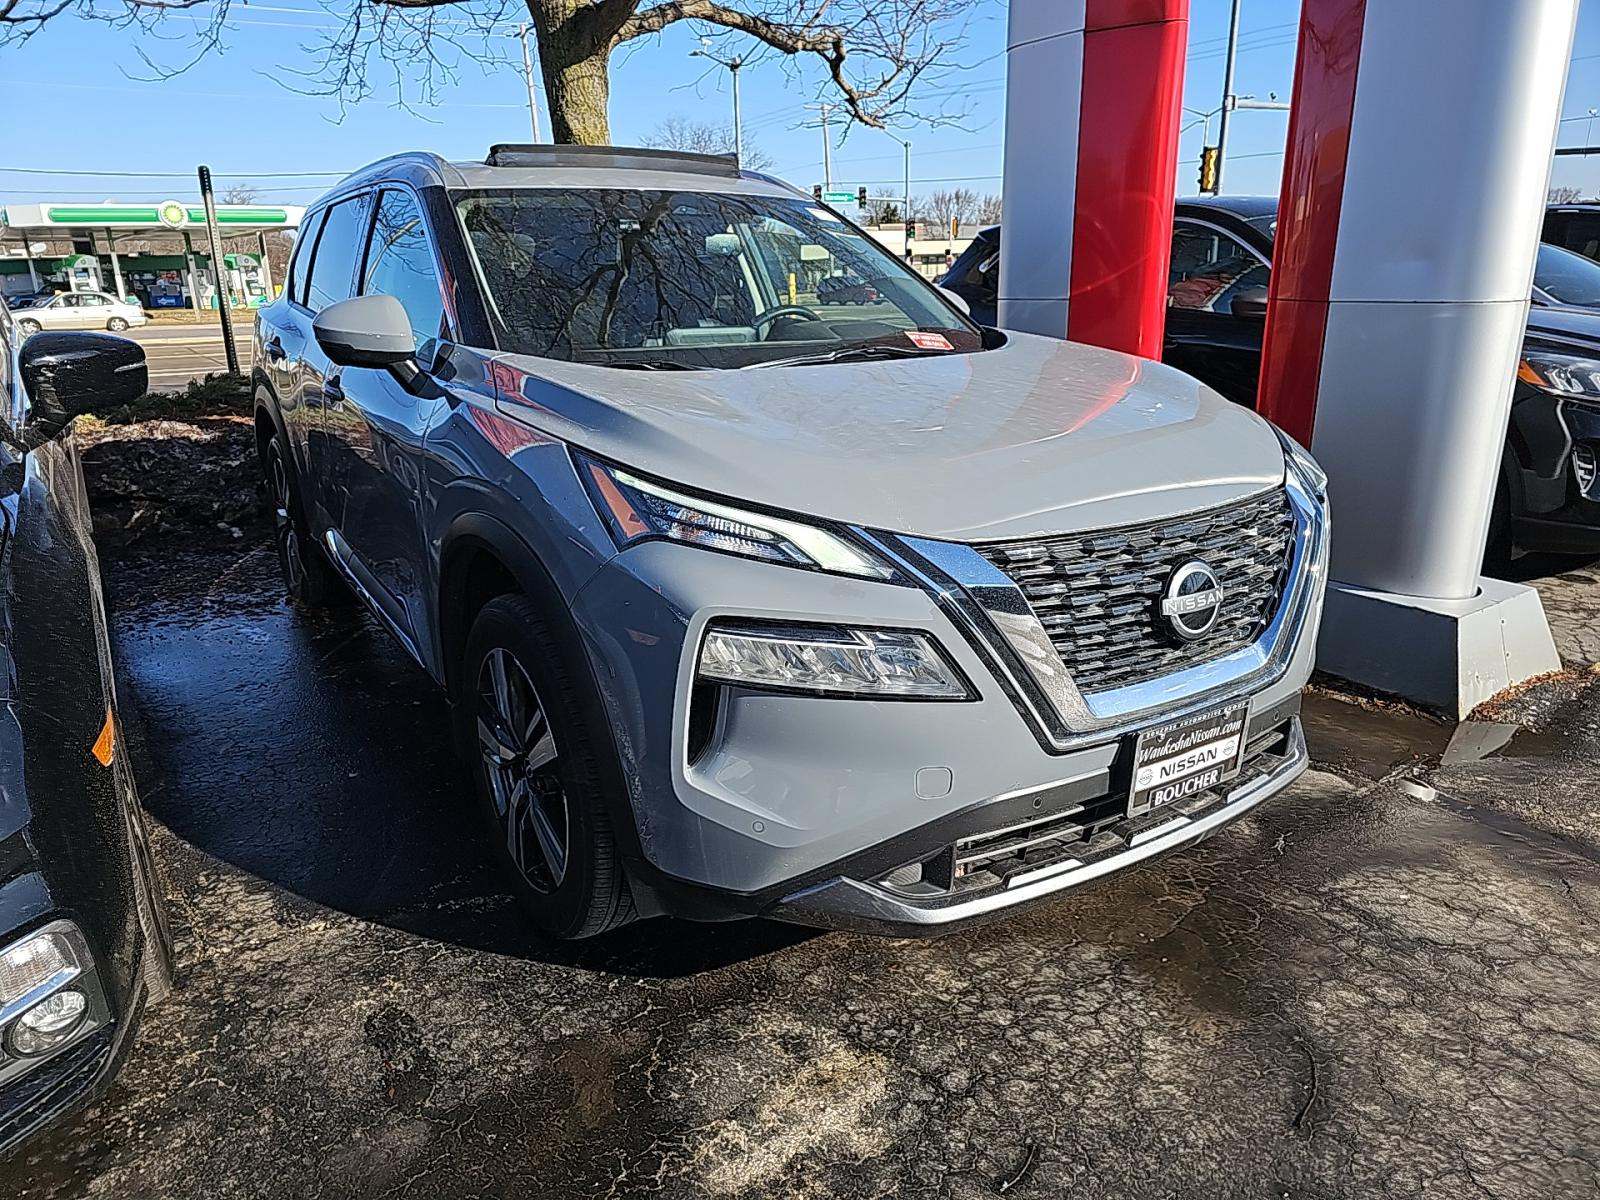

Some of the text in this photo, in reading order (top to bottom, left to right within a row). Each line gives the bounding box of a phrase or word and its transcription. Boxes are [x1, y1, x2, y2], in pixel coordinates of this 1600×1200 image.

[1165, 587, 1223, 613] NISSAN
[1138, 719, 1243, 763] WaukeshaNissan.com
[1160, 746, 1218, 778] NISSAN
[1154, 769, 1218, 806] BOUCHER
